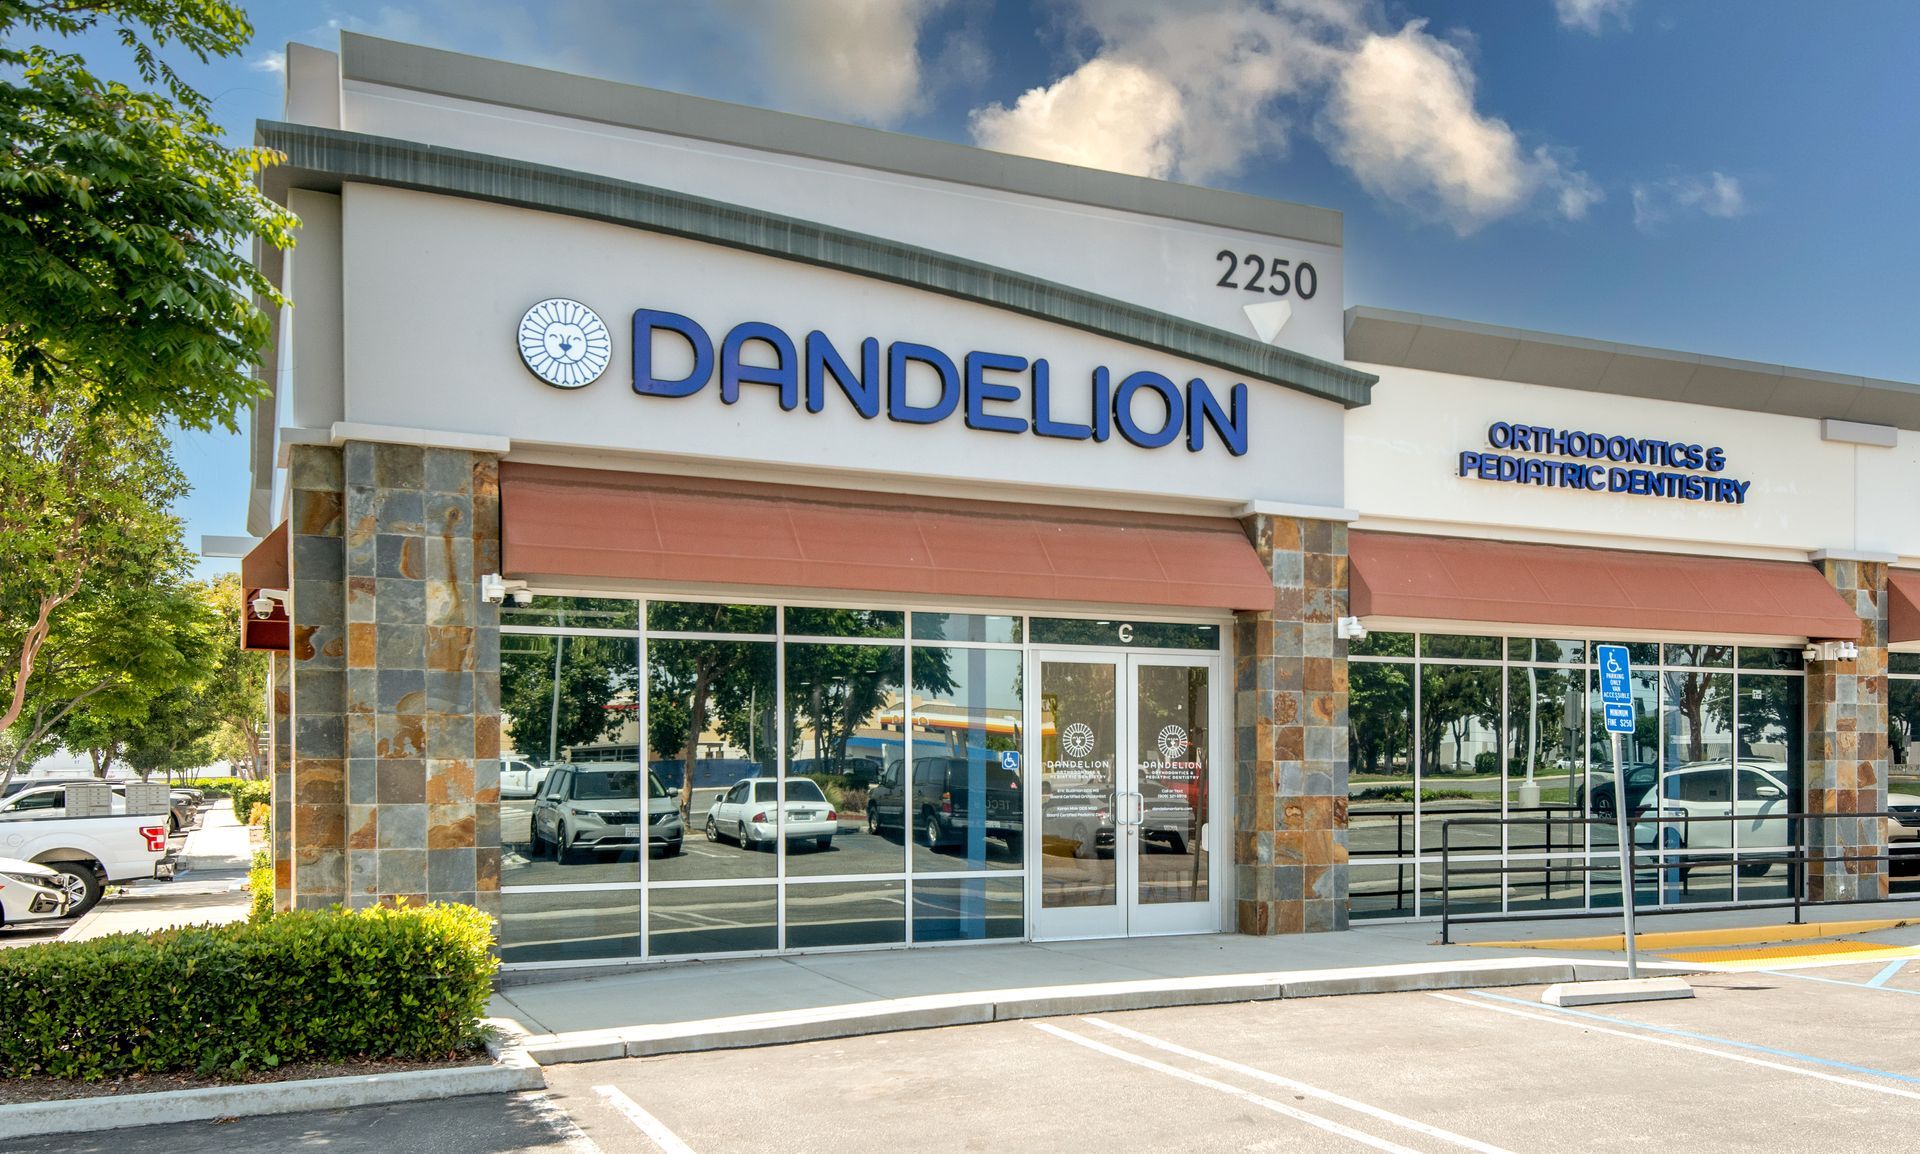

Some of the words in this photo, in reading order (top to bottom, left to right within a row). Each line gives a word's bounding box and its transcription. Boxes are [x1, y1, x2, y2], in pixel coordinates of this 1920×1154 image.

[1216, 250, 1317, 300] 2250
[631, 308, 1248, 457] DANDELION
[1488, 421, 1704, 470] ORTHODONTICS
[1705, 447, 1727, 472] &
[1458, 450, 1606, 491] PEDIATRIC
[1608, 467, 1751, 504] DENTISTRY
[1118, 623, 1134, 643] C
[1607, 718, 1618, 727] FINE
[1619, 719, 1633, 728] $250
[1610, 709, 1628, 717] MINIMUM
[1047, 760, 1109, 768] DANDELION
[1143, 761, 1202, 769] DANDELION
